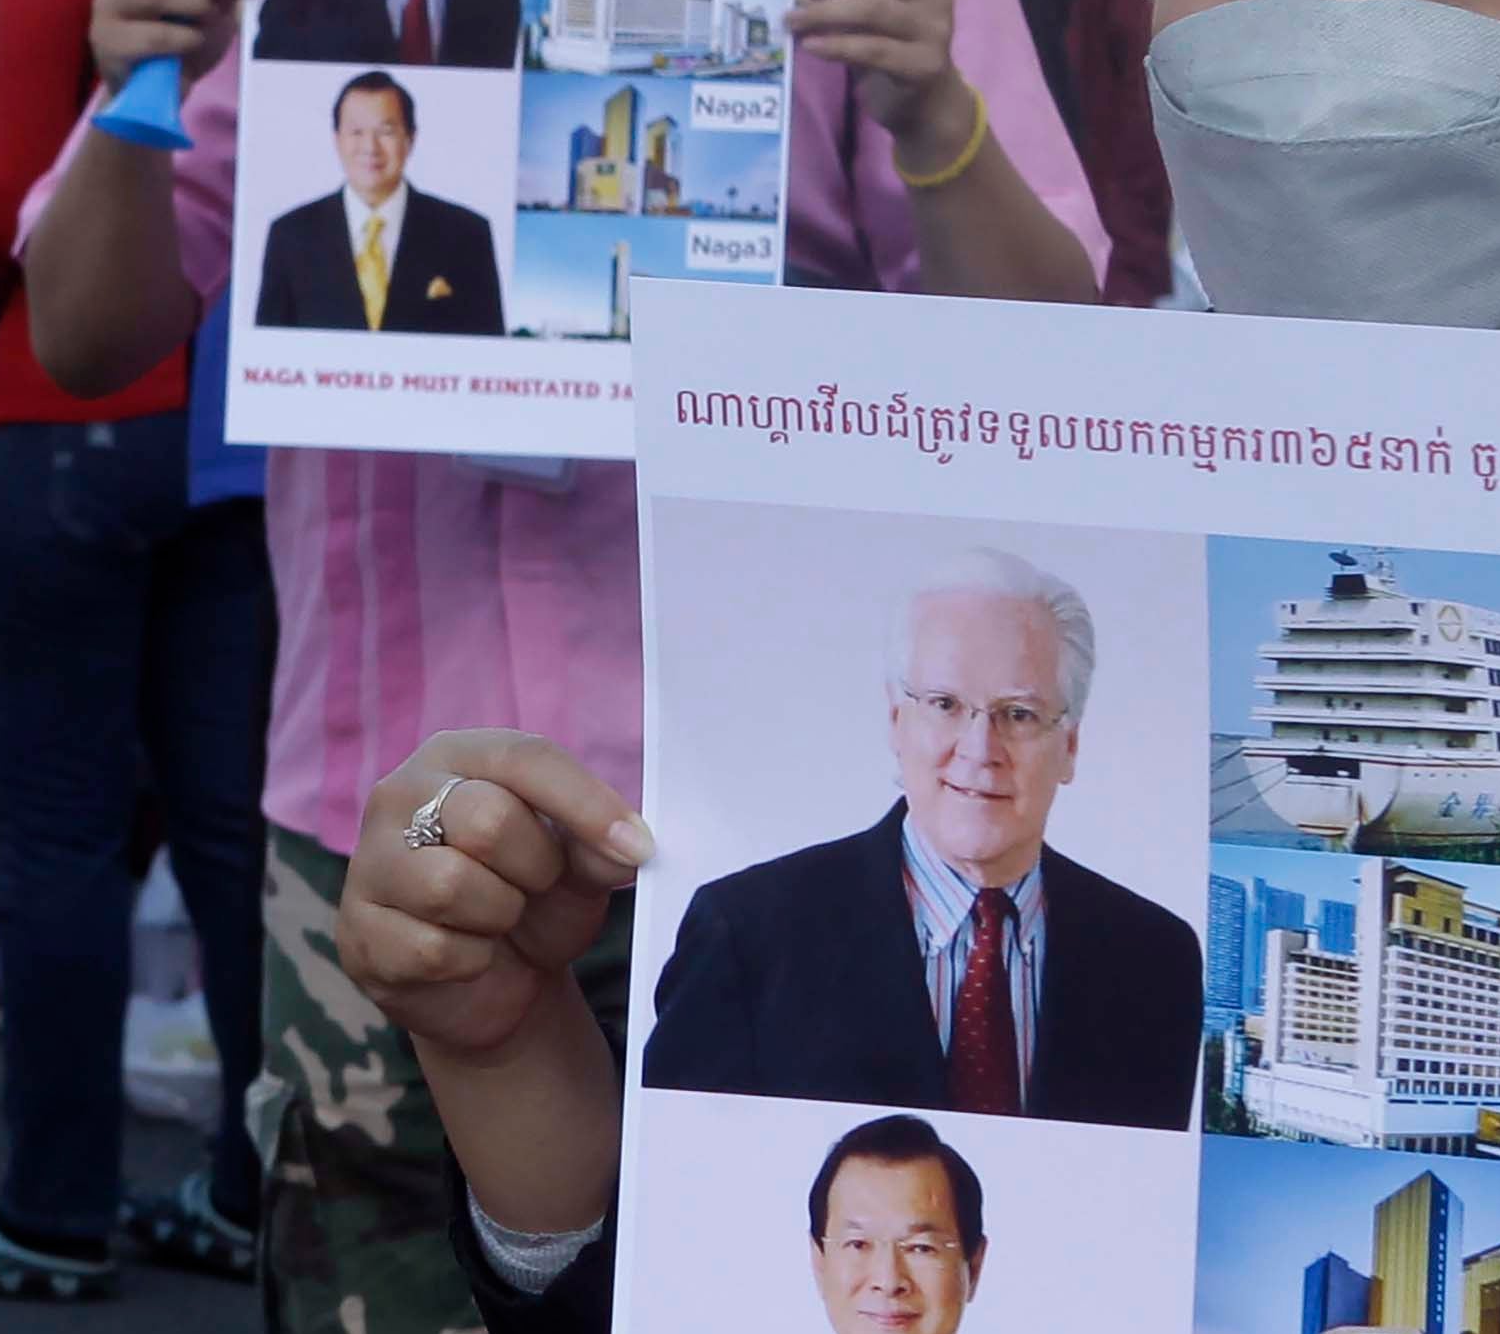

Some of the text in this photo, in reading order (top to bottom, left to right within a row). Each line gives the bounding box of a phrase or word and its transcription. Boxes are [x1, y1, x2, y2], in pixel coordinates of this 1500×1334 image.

[694, 94, 778, 124] Naga2
[691, 234, 773, 263] Naga3
[243, 367, 307, 386] NAGA
[314, 371, 394, 390] WORLD
[401, 374, 461, 393] MUST
[469, 376, 601, 399] REINSTATED
